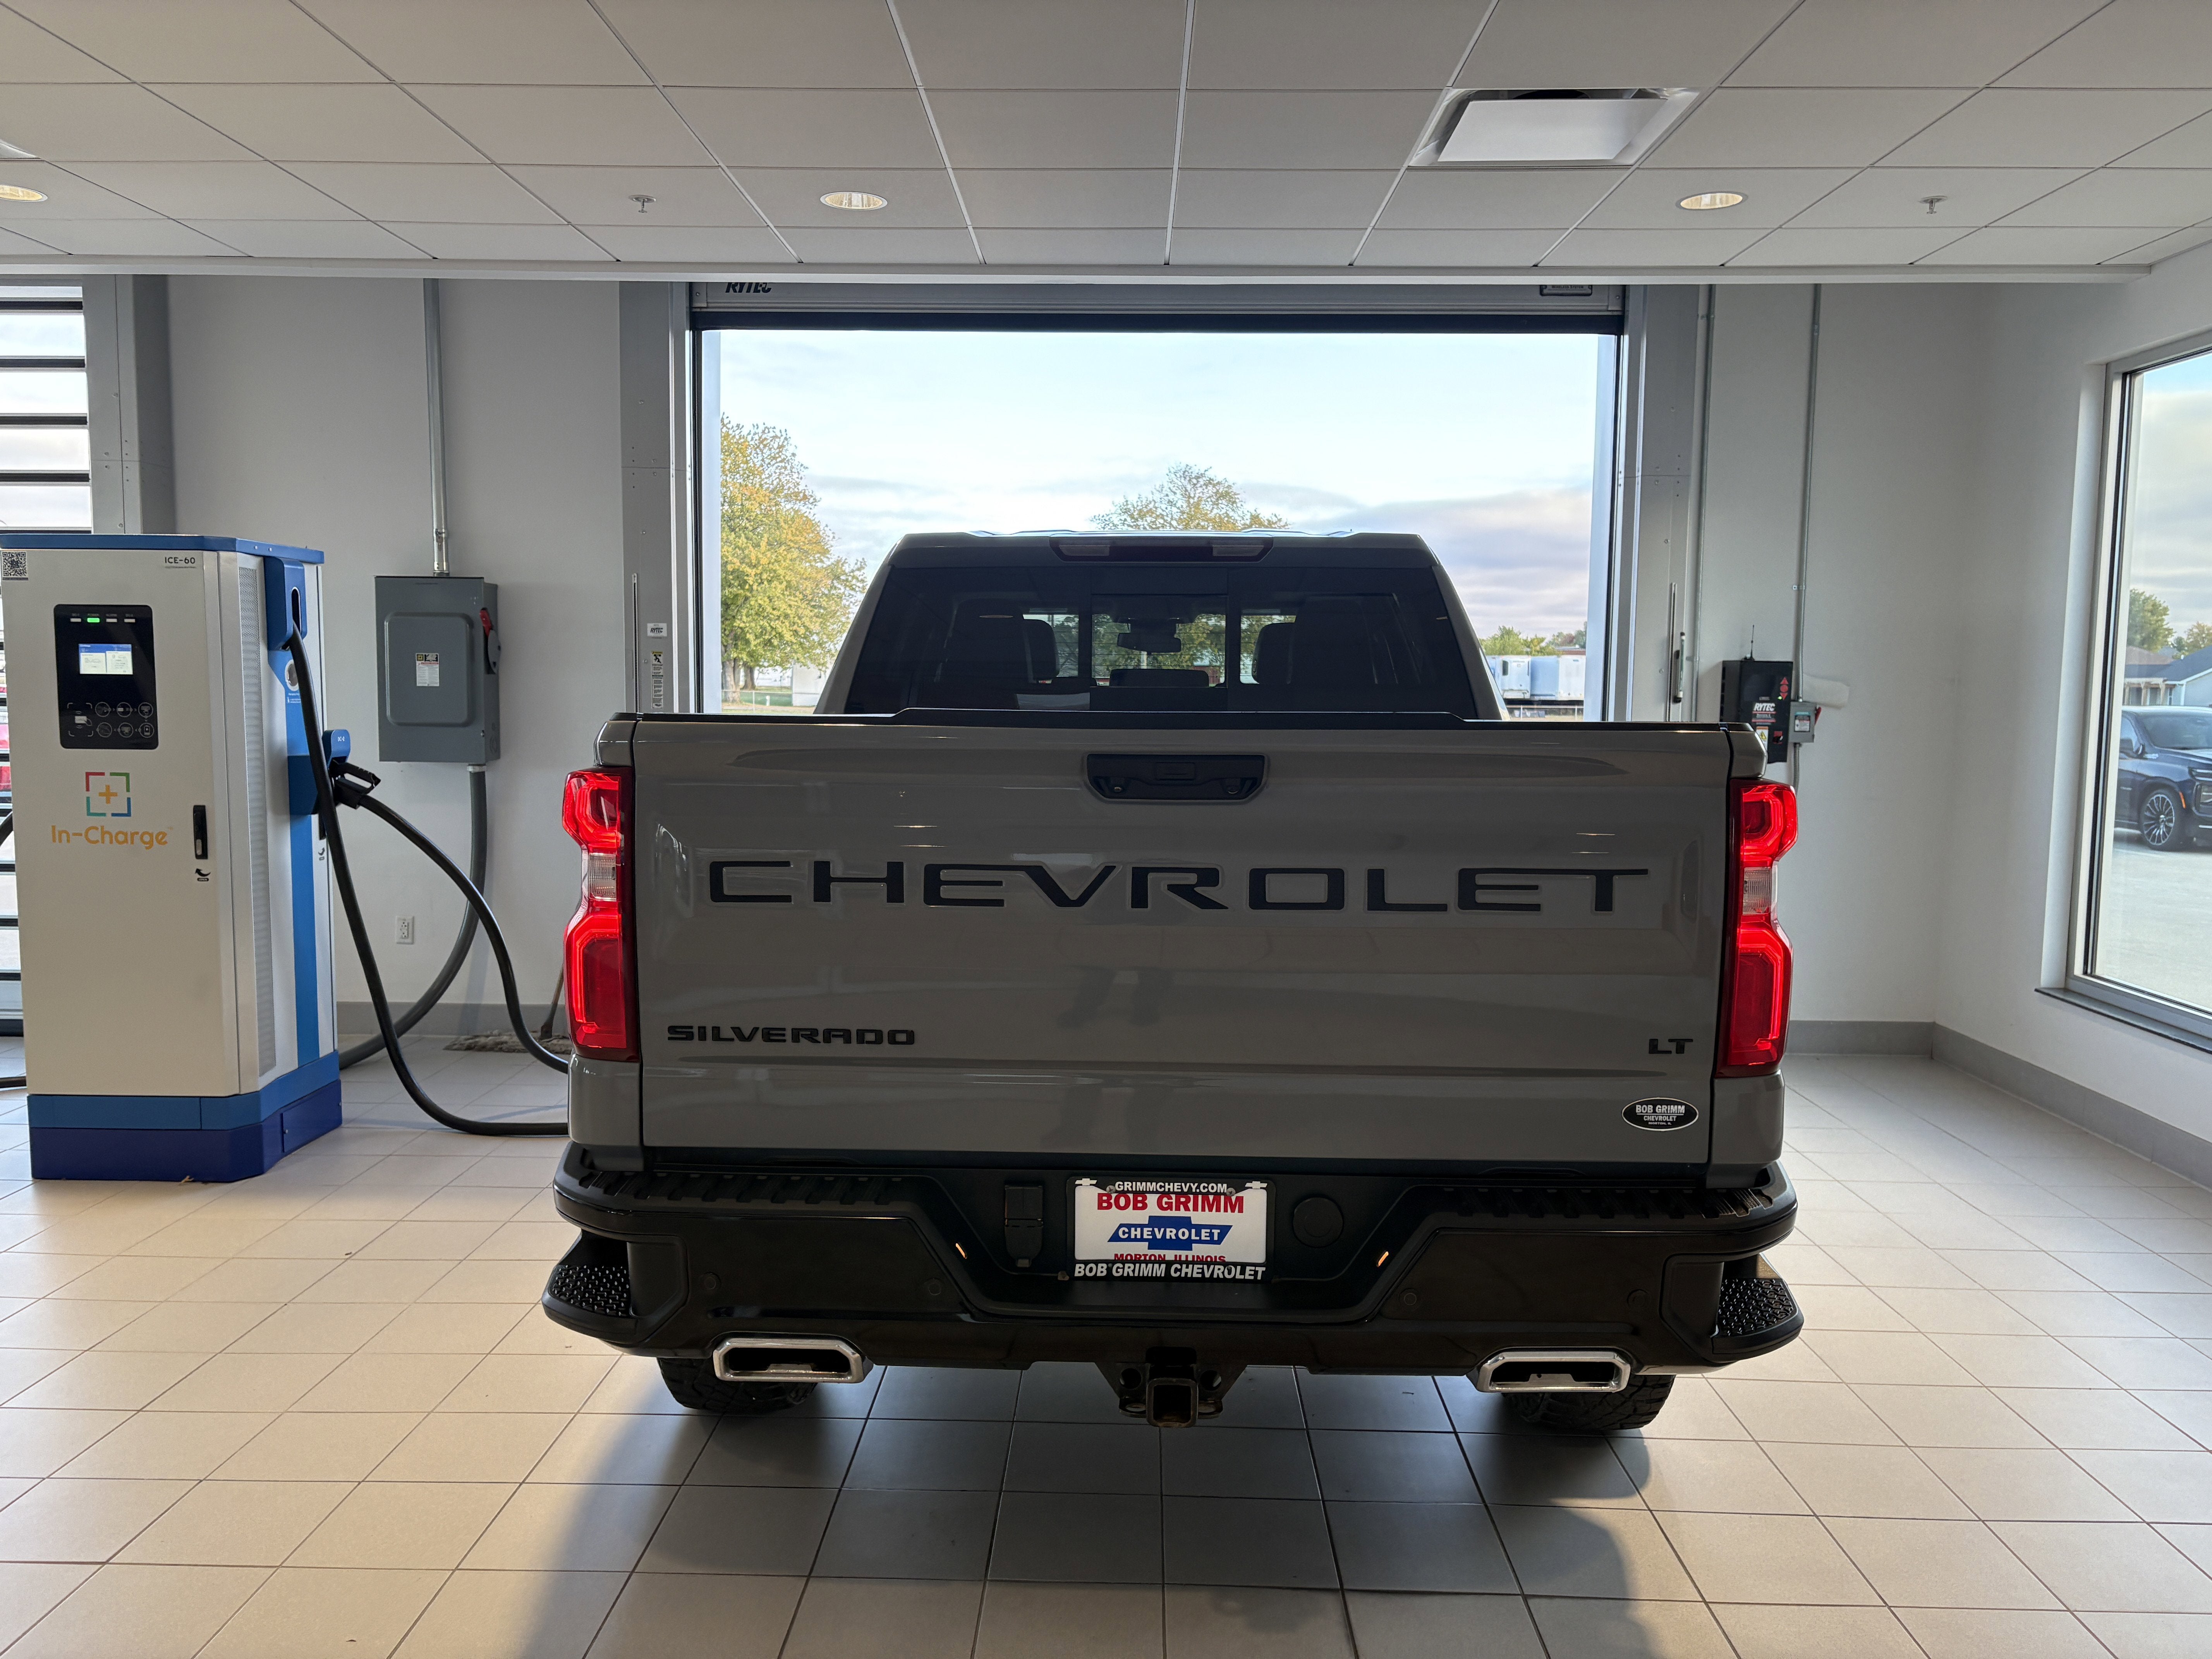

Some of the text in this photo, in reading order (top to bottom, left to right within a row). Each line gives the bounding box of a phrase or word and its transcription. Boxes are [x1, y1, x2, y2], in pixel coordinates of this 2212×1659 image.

[1753, 702, 1775, 711] RYTEC
[51, 825, 168, 850] In-Charge
[709, 861, 1648, 912] CHEVROLET
[667, 1025, 915, 1045] SILVERADO
[1649, 1039, 1693, 1054] LT
[1636, 1105, 1685, 1114] BOB GRIMM
[1115, 1182, 1228, 1193] GRIMMCHEVY.COM
[1097, 1193, 1244, 1213] BOB GRIMM
[1118, 1227, 1221, 1241] CHEVROLET
[1074, 1263, 1266, 1280] BOB GRIMM CHEVROLET
